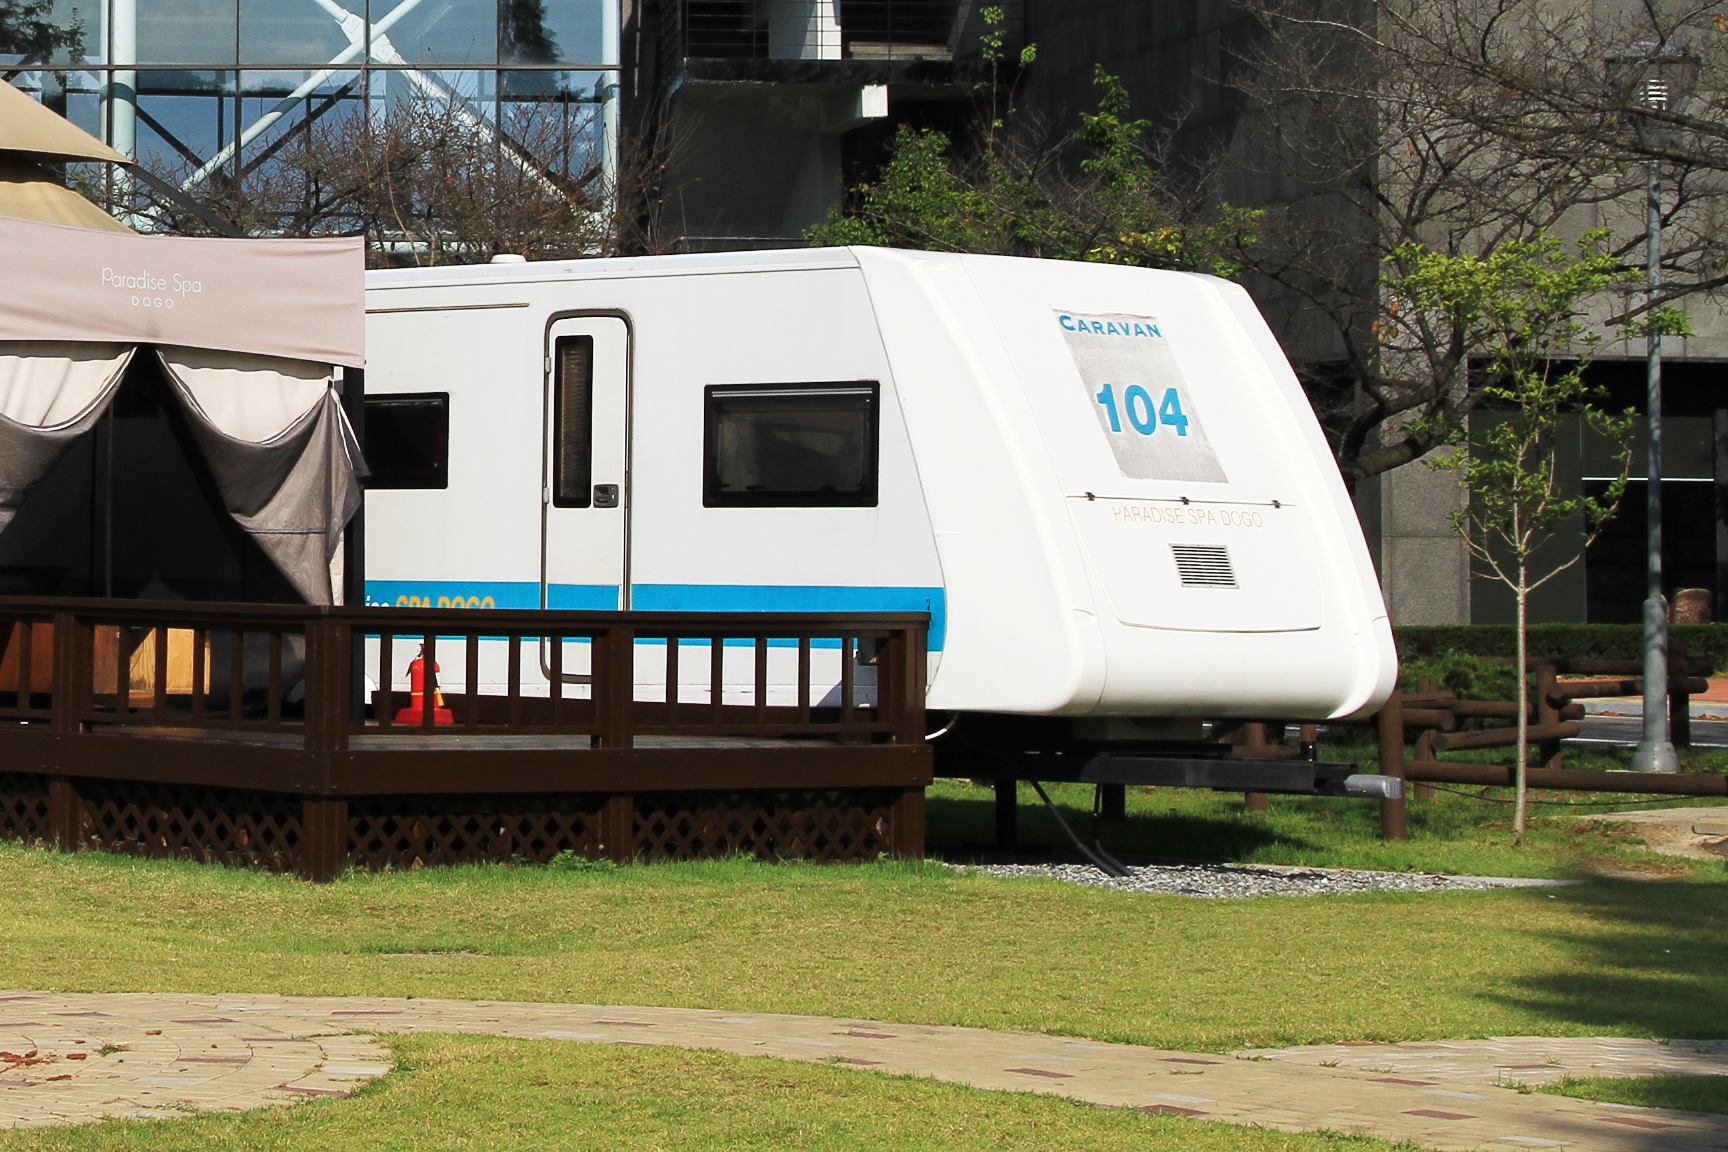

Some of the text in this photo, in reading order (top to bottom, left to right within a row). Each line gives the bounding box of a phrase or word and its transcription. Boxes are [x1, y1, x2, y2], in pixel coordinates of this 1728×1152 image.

[101, 266, 203, 298] Paradise Spa
[131, 295, 175, 309] DOGO
[1058, 314, 1163, 338] CARAVAN
[1096, 383, 1189, 437] 104
[1111, 506, 1264, 528] PARADISE SPA DOGO
